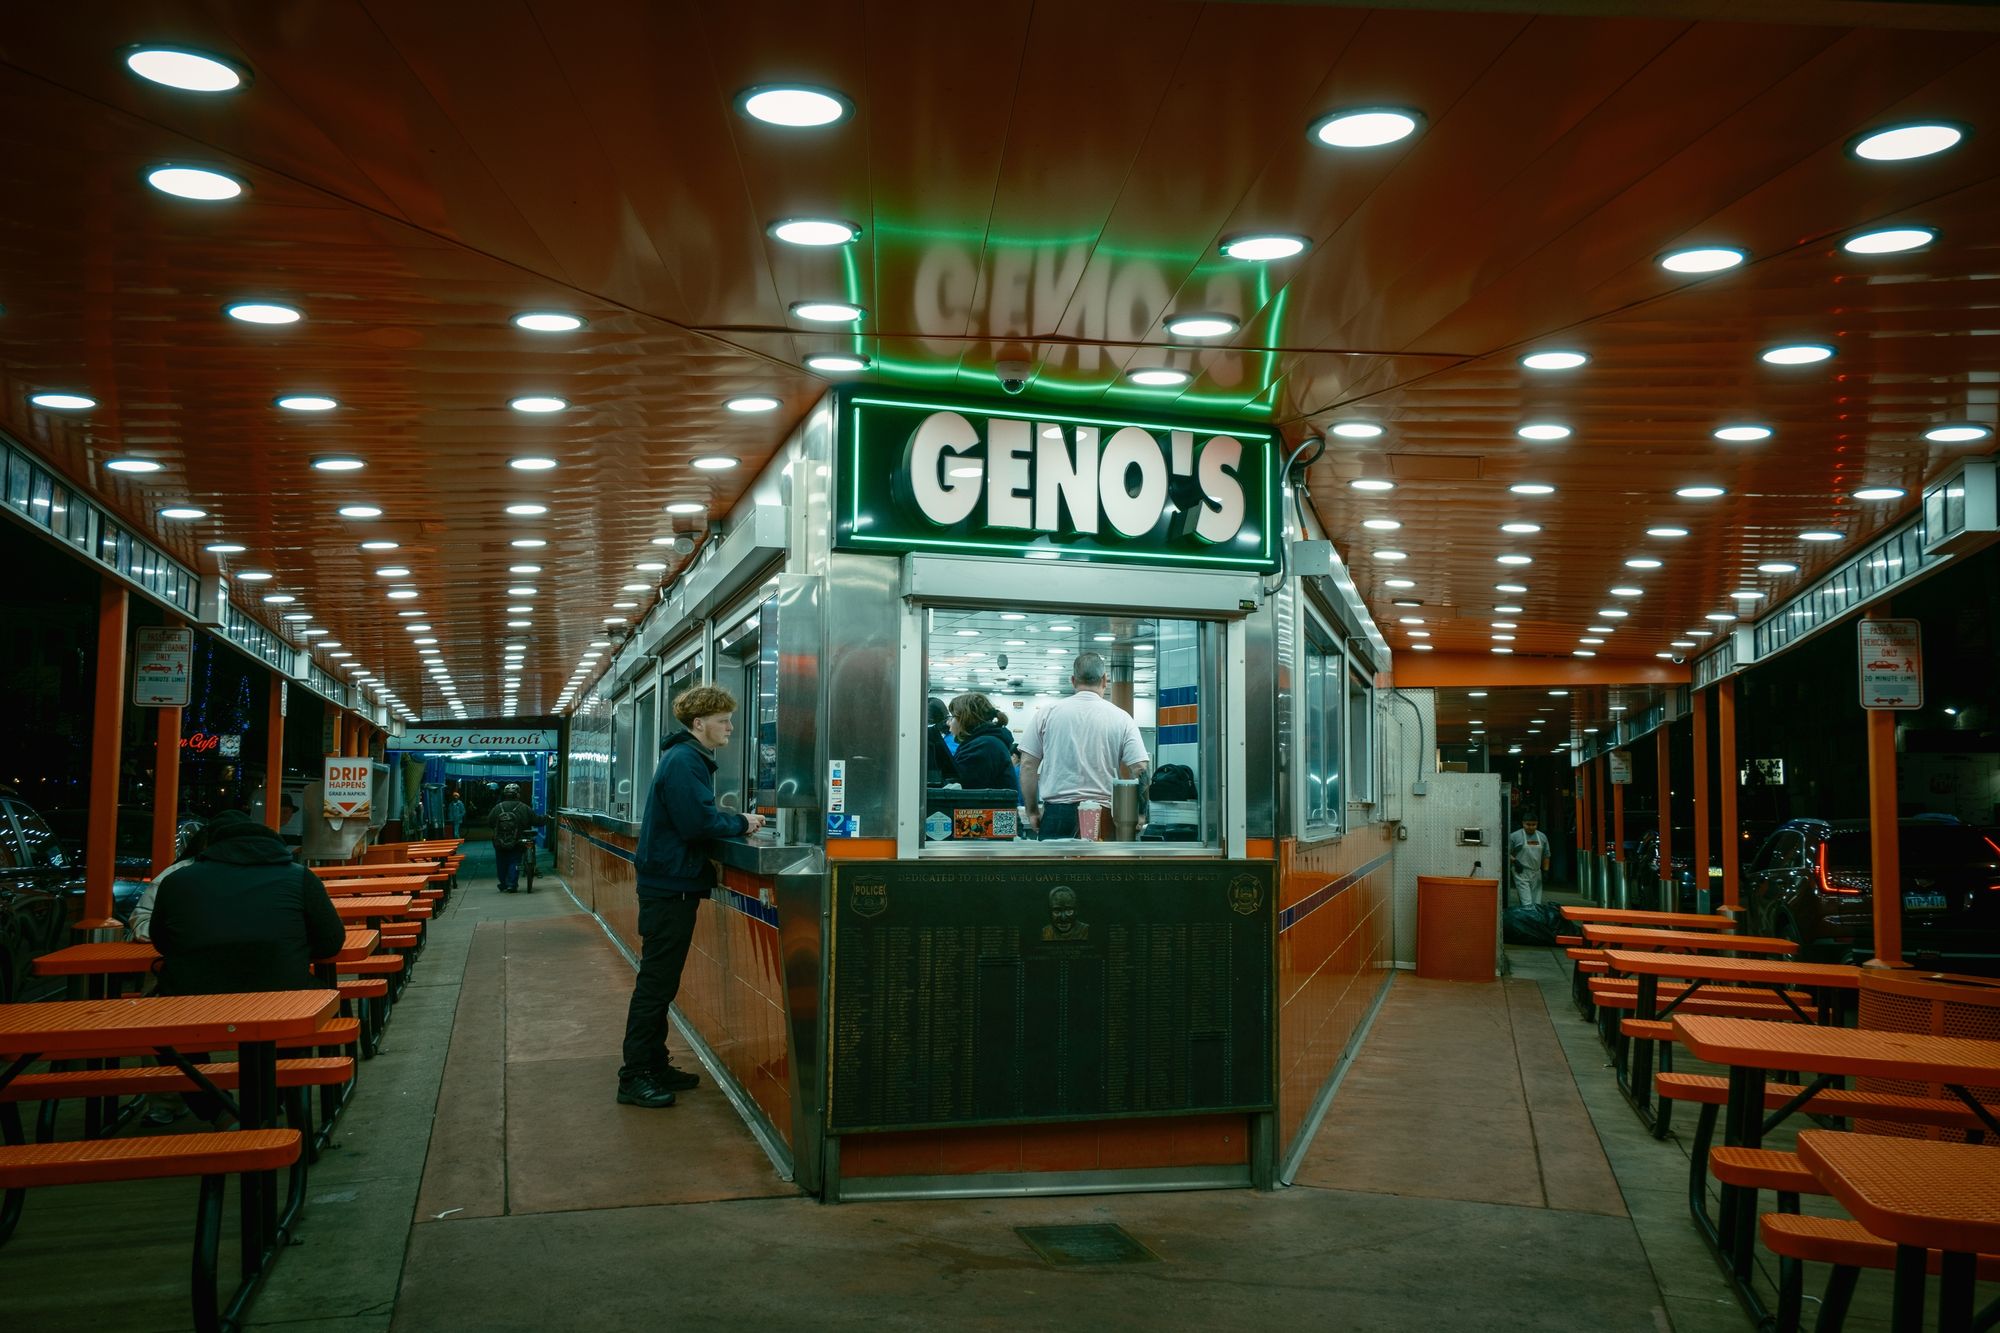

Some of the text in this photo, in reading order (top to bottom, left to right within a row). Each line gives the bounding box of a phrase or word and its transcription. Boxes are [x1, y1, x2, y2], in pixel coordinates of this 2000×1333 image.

[909, 411, 1246, 543] GENO'S
[1870, 626, 1907, 635] PASSENGER
[155, 653, 170, 661] ONLY
[1881, 648, 1898, 657] ONLY
[189, 733, 220, 753] Café
[414, 732, 541, 748] King Cannoli
[329, 766, 368, 781] DRIP
[329, 781, 367, 789] HAPPENS
[898, 872, 956, 882] DEDICATED
[959, 872, 972, 882] TO
[975, 872, 1007, 882] THOSE
[1010, 872, 1032, 882] WHO
[1034, 872, 1061, 882] GAVE
[1064, 872, 1092, 882] THEIR
[1096, 872, 1121, 882] LIVES
[1125, 872, 1136, 882] IN
[1138, 872, 1155, 882] THE
[1158, 872, 1180, 882] LINE
[1183, 872, 1194, 882] OF
[855, 885, 885, 896] POLICE
